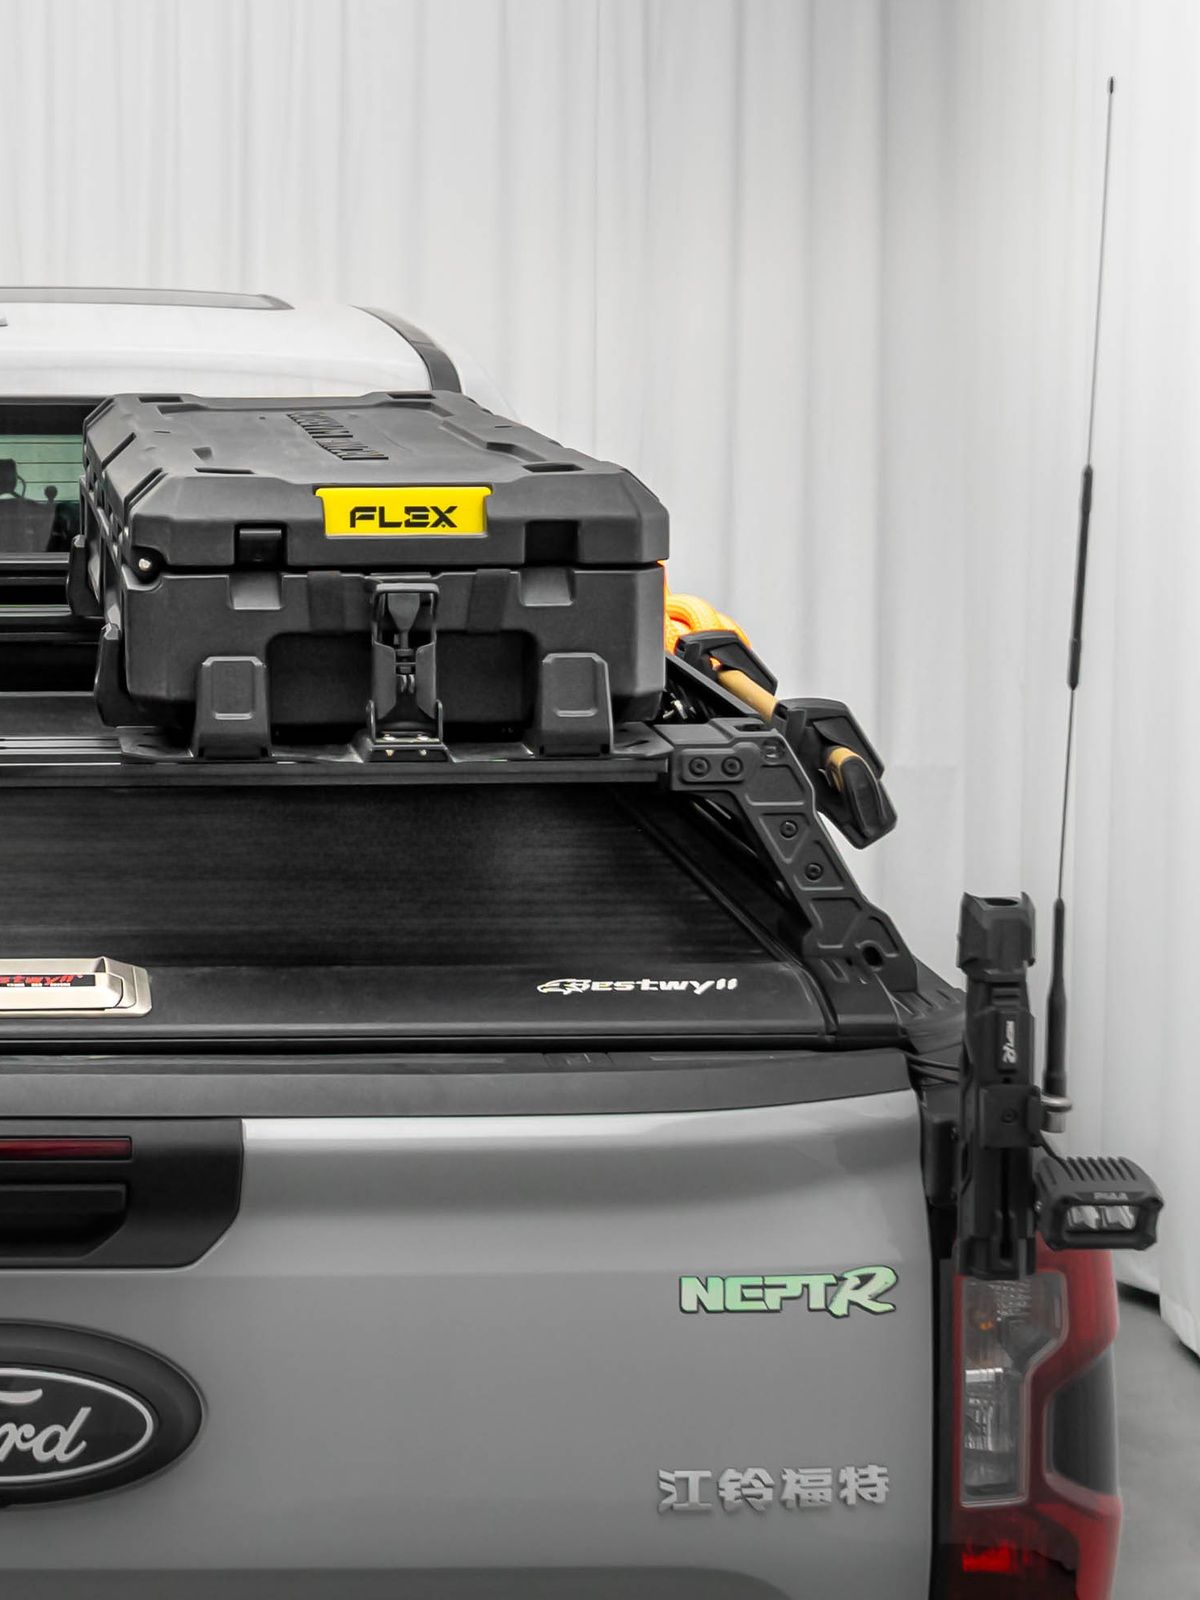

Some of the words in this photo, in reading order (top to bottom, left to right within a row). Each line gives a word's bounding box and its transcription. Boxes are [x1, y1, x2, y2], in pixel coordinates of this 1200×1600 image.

[350, 506, 458, 528] FLEX
[657, 1464, 890, 1513] 江铃福特
